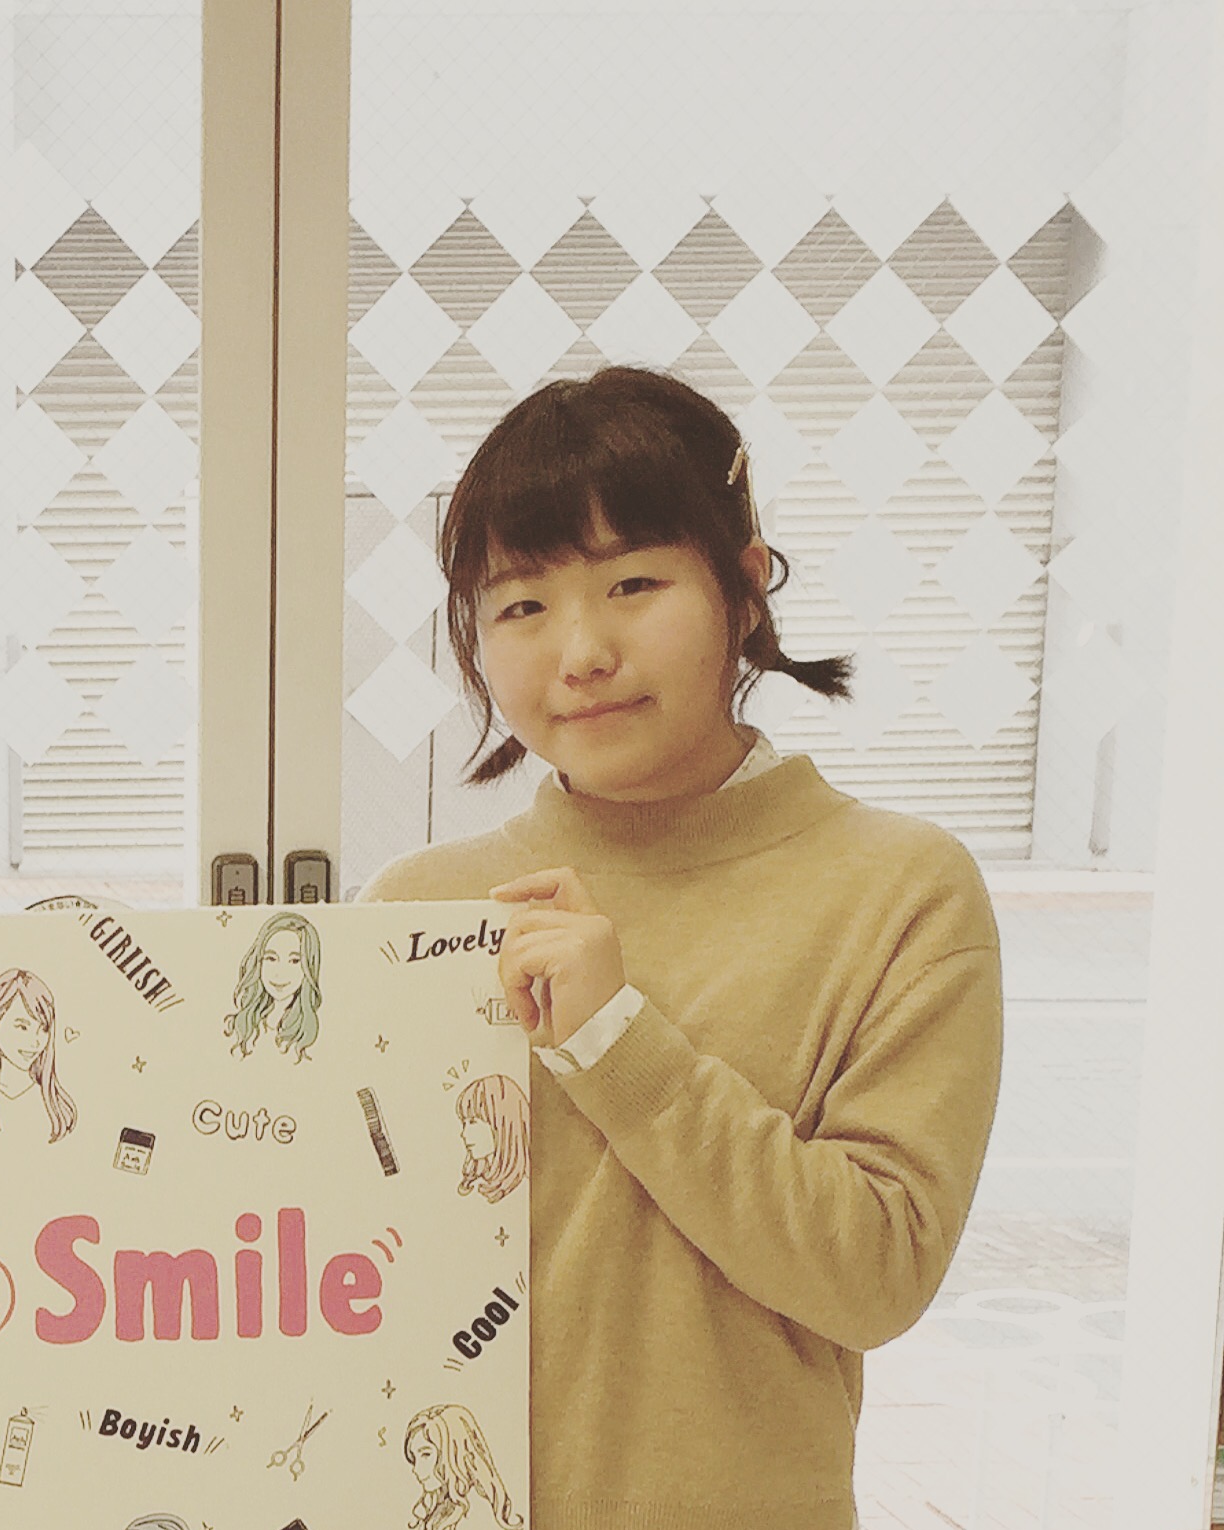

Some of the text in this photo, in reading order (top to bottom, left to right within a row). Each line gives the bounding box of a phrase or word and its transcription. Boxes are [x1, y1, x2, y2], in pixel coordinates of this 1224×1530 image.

[89, 916, 173, 1006] GIRLISH
[407, 919, 507, 963] Lovely
[192, 1100, 298, 1144] Cute
[34, 1207, 384, 1345] Smile
[452, 1286, 520, 1360] Cool
[98, 1408, 202, 1454] Boyish
